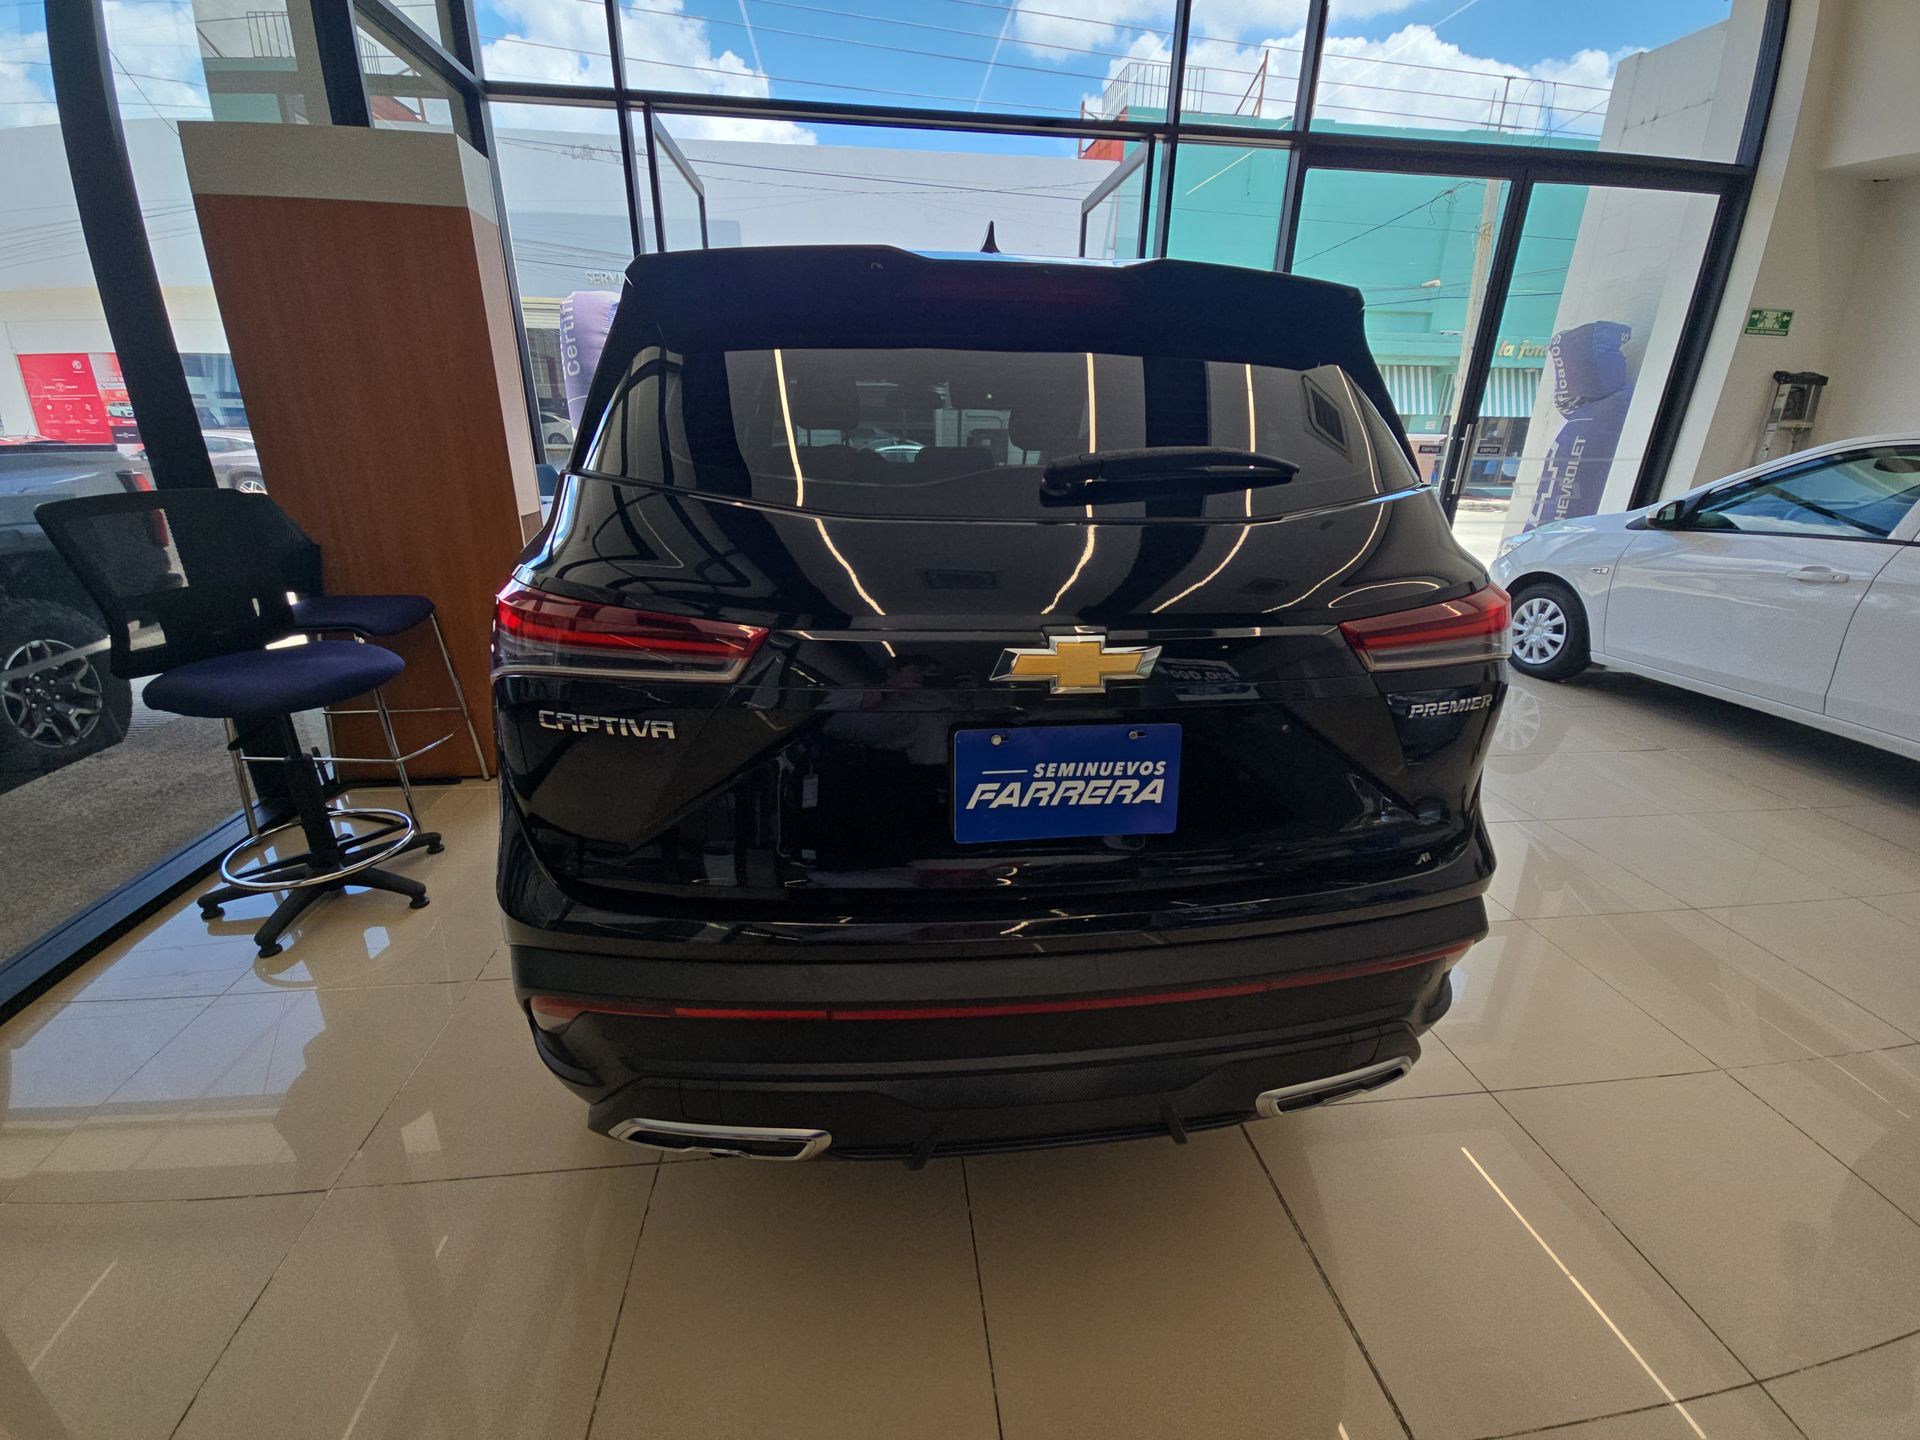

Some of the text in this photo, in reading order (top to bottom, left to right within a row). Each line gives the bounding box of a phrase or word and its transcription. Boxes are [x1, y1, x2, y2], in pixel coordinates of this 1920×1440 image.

[584, 271, 625, 285] SERVI
[1516, 339, 1547, 360] fon
[1554, 435, 1586, 520] HEVROLET
[1408, 693, 1493, 719] PREMIER
[538, 709, 676, 739] CAPTIVA
[1033, 760, 1167, 778] SEMINUEVOS
[965, 778, 1165, 810] FARRERA
